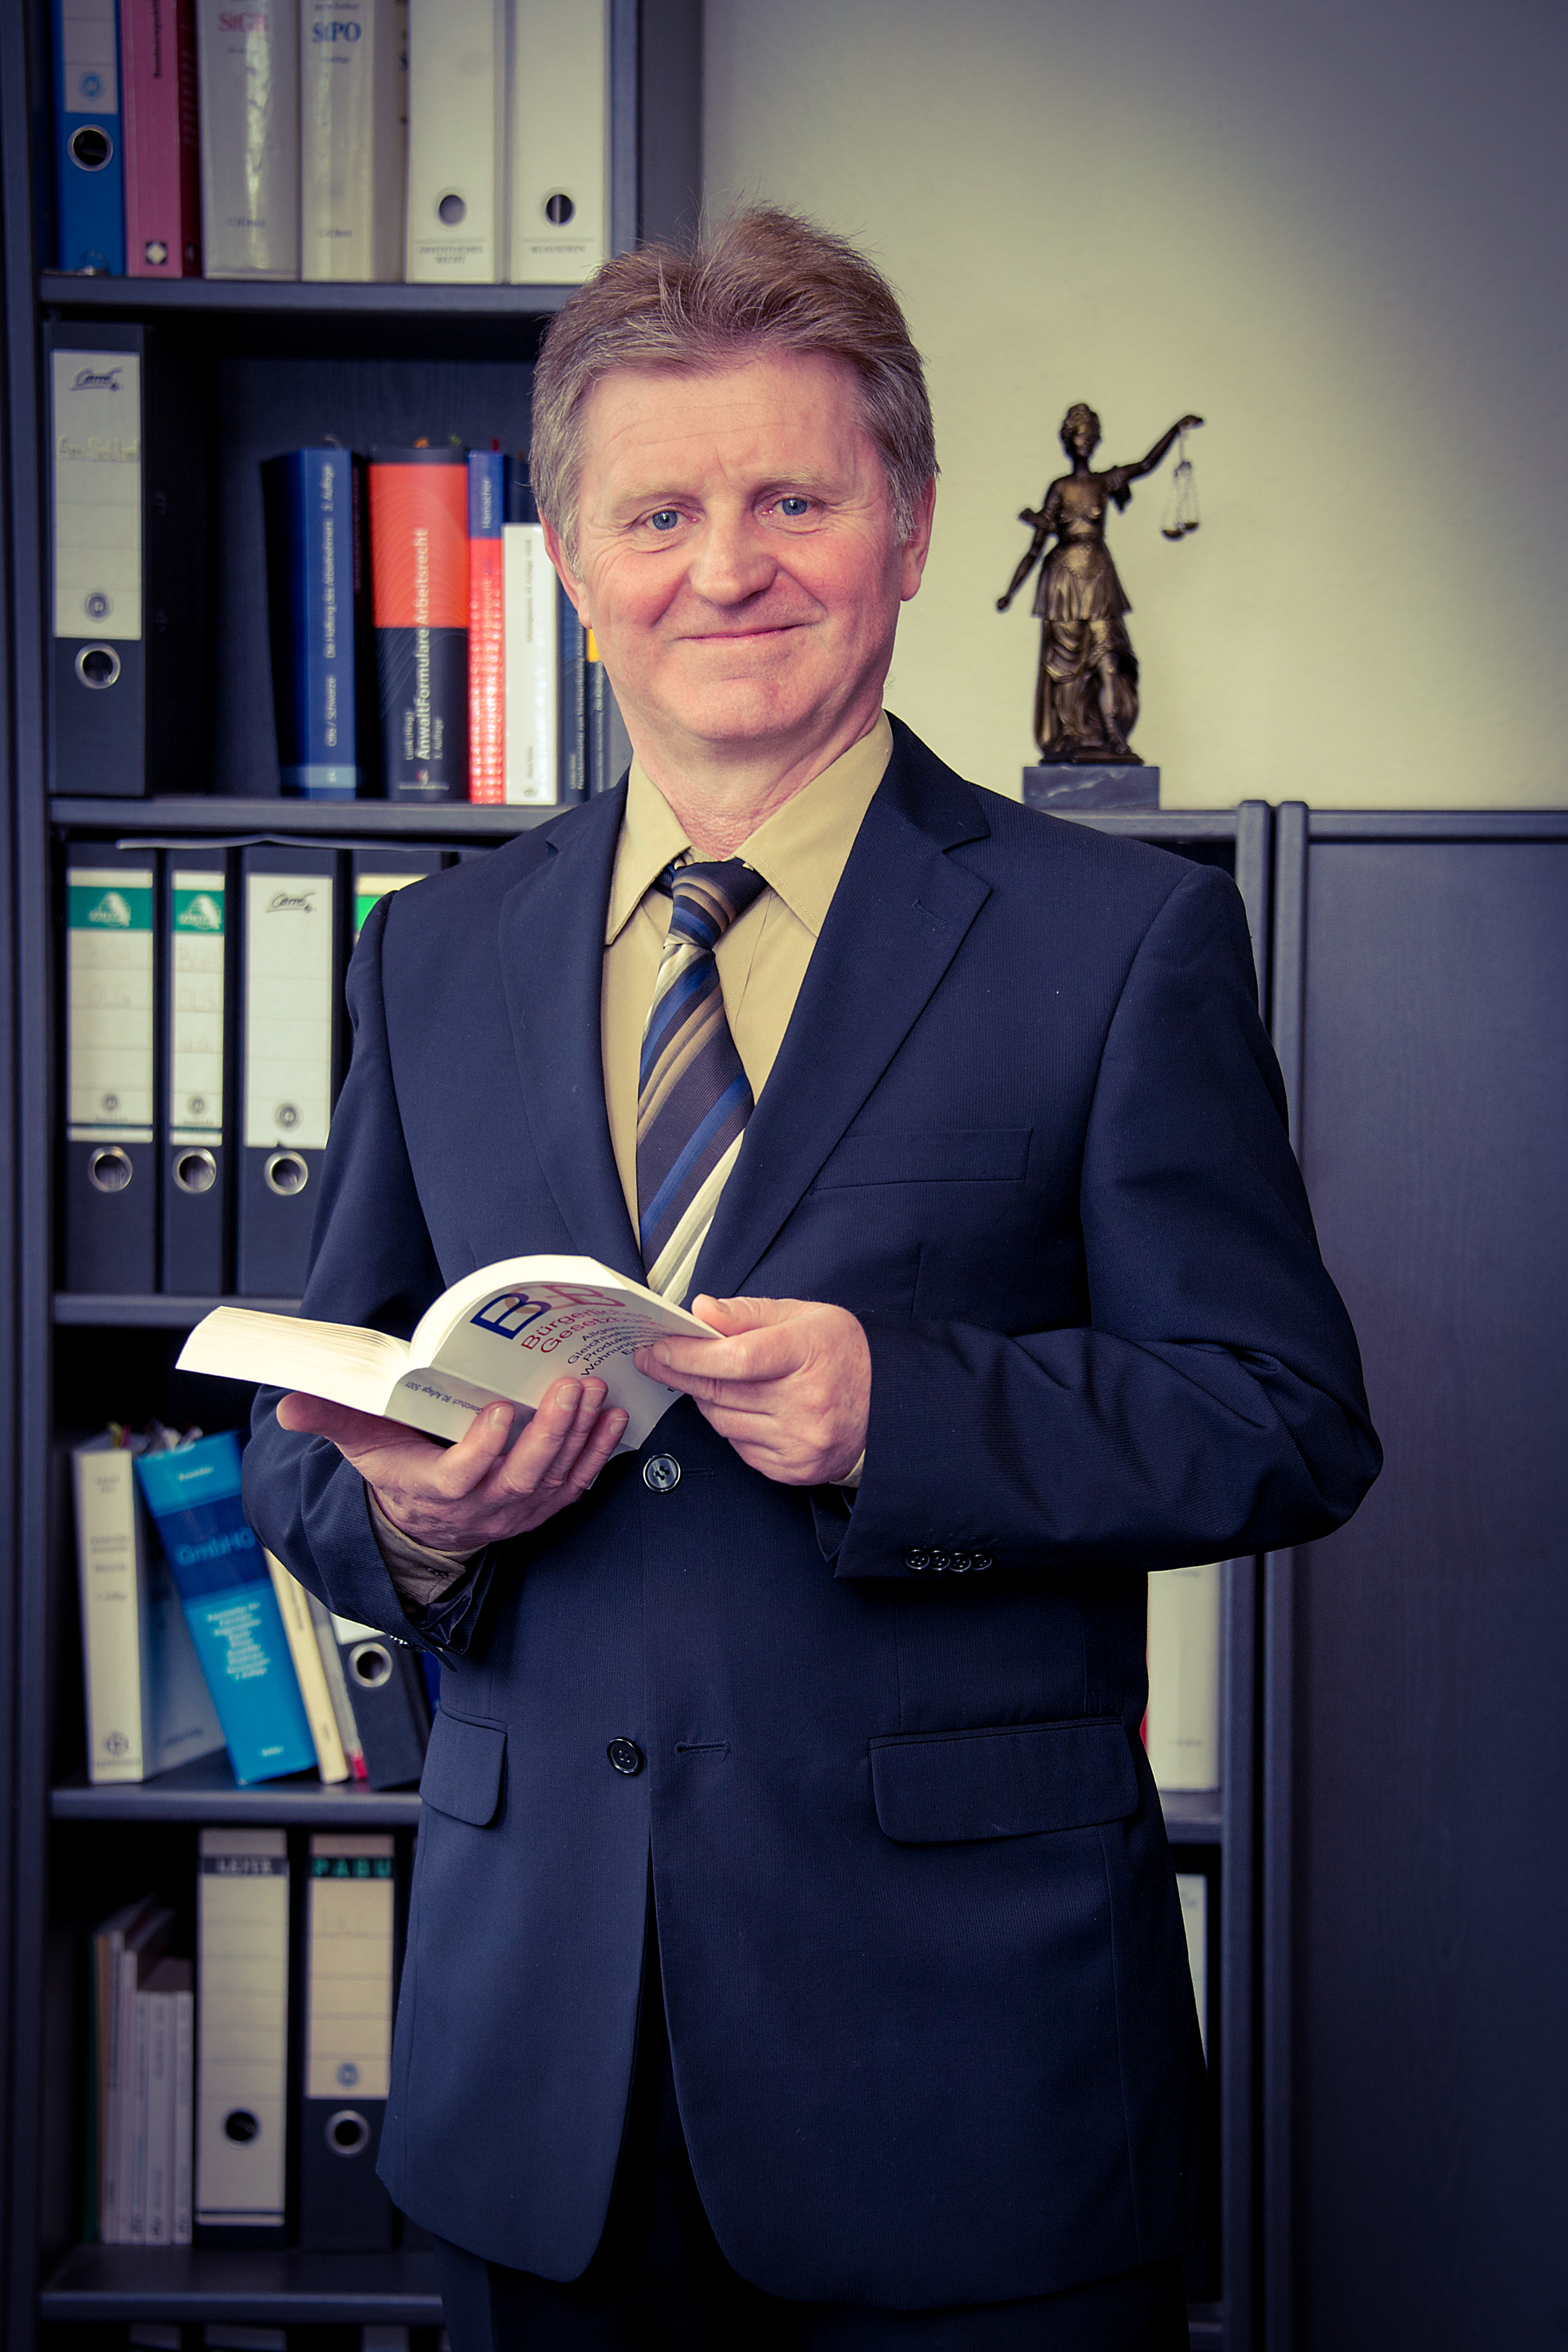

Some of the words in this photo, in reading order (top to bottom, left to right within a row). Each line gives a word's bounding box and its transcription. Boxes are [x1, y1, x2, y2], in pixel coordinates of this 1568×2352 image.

[312, 21, 362, 43] StPO
[322, 466, 336, 502] Auflage
[481, 479, 492, 529] Hamacher
[323, 521, 336, 586] Arbeitnehmers
[412, 529, 429, 625] Arbeitsrecht
[324, 606, 337, 642] Haftung
[326, 678, 336, 720] Schwarze
[414, 629, 431, 760] AnwaltFormulare
[404, 1381, 421, 1392] 5001
